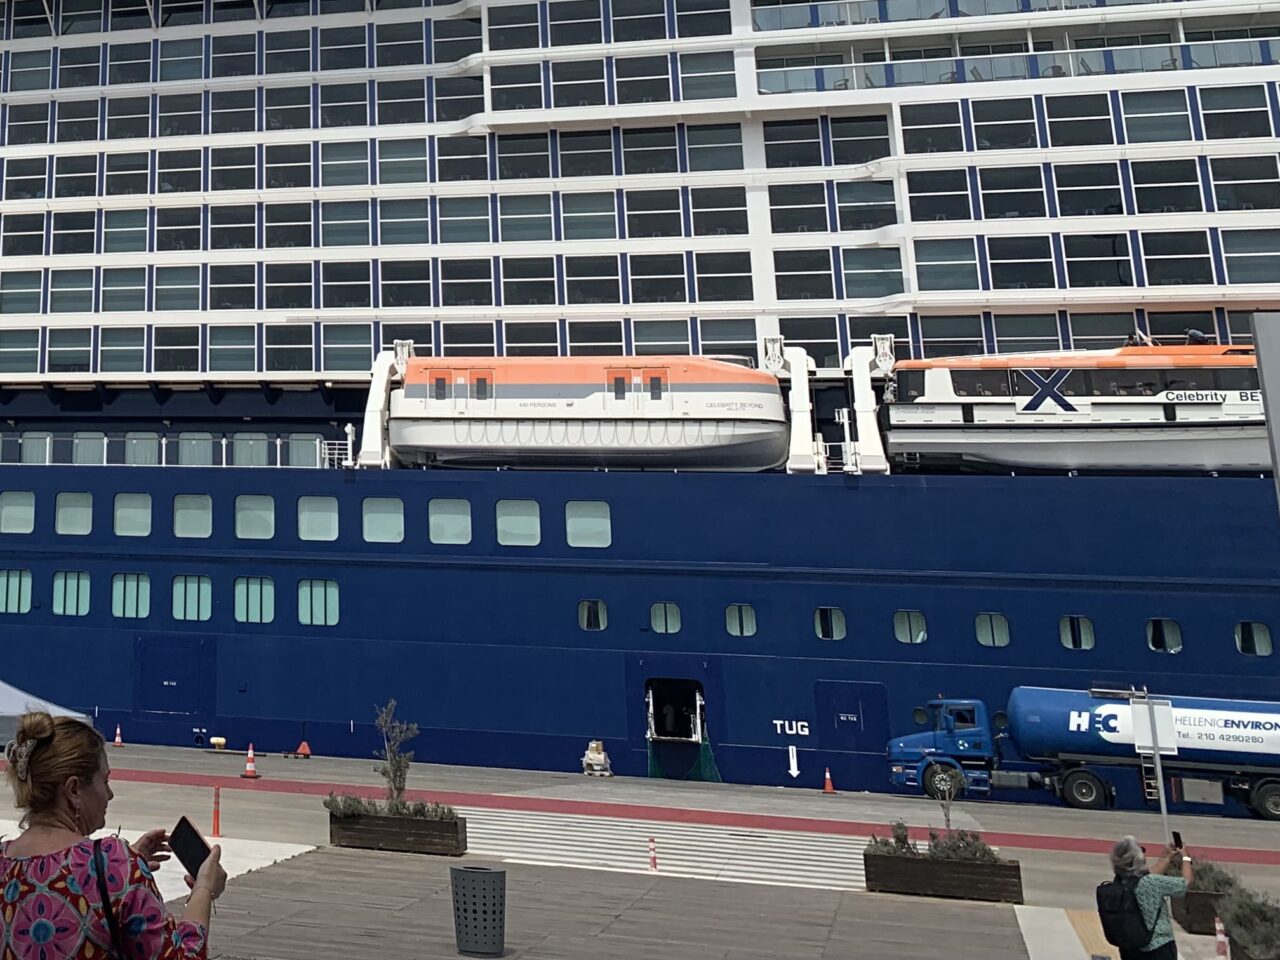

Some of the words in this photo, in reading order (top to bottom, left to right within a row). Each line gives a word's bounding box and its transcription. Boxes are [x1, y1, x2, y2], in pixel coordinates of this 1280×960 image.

[1165, 391, 1227, 403] Celebrity
[772, 720, 809, 735] TUG
[1197, 732, 1215, 741] 210
[1218, 733, 1264, 744] 4290280
